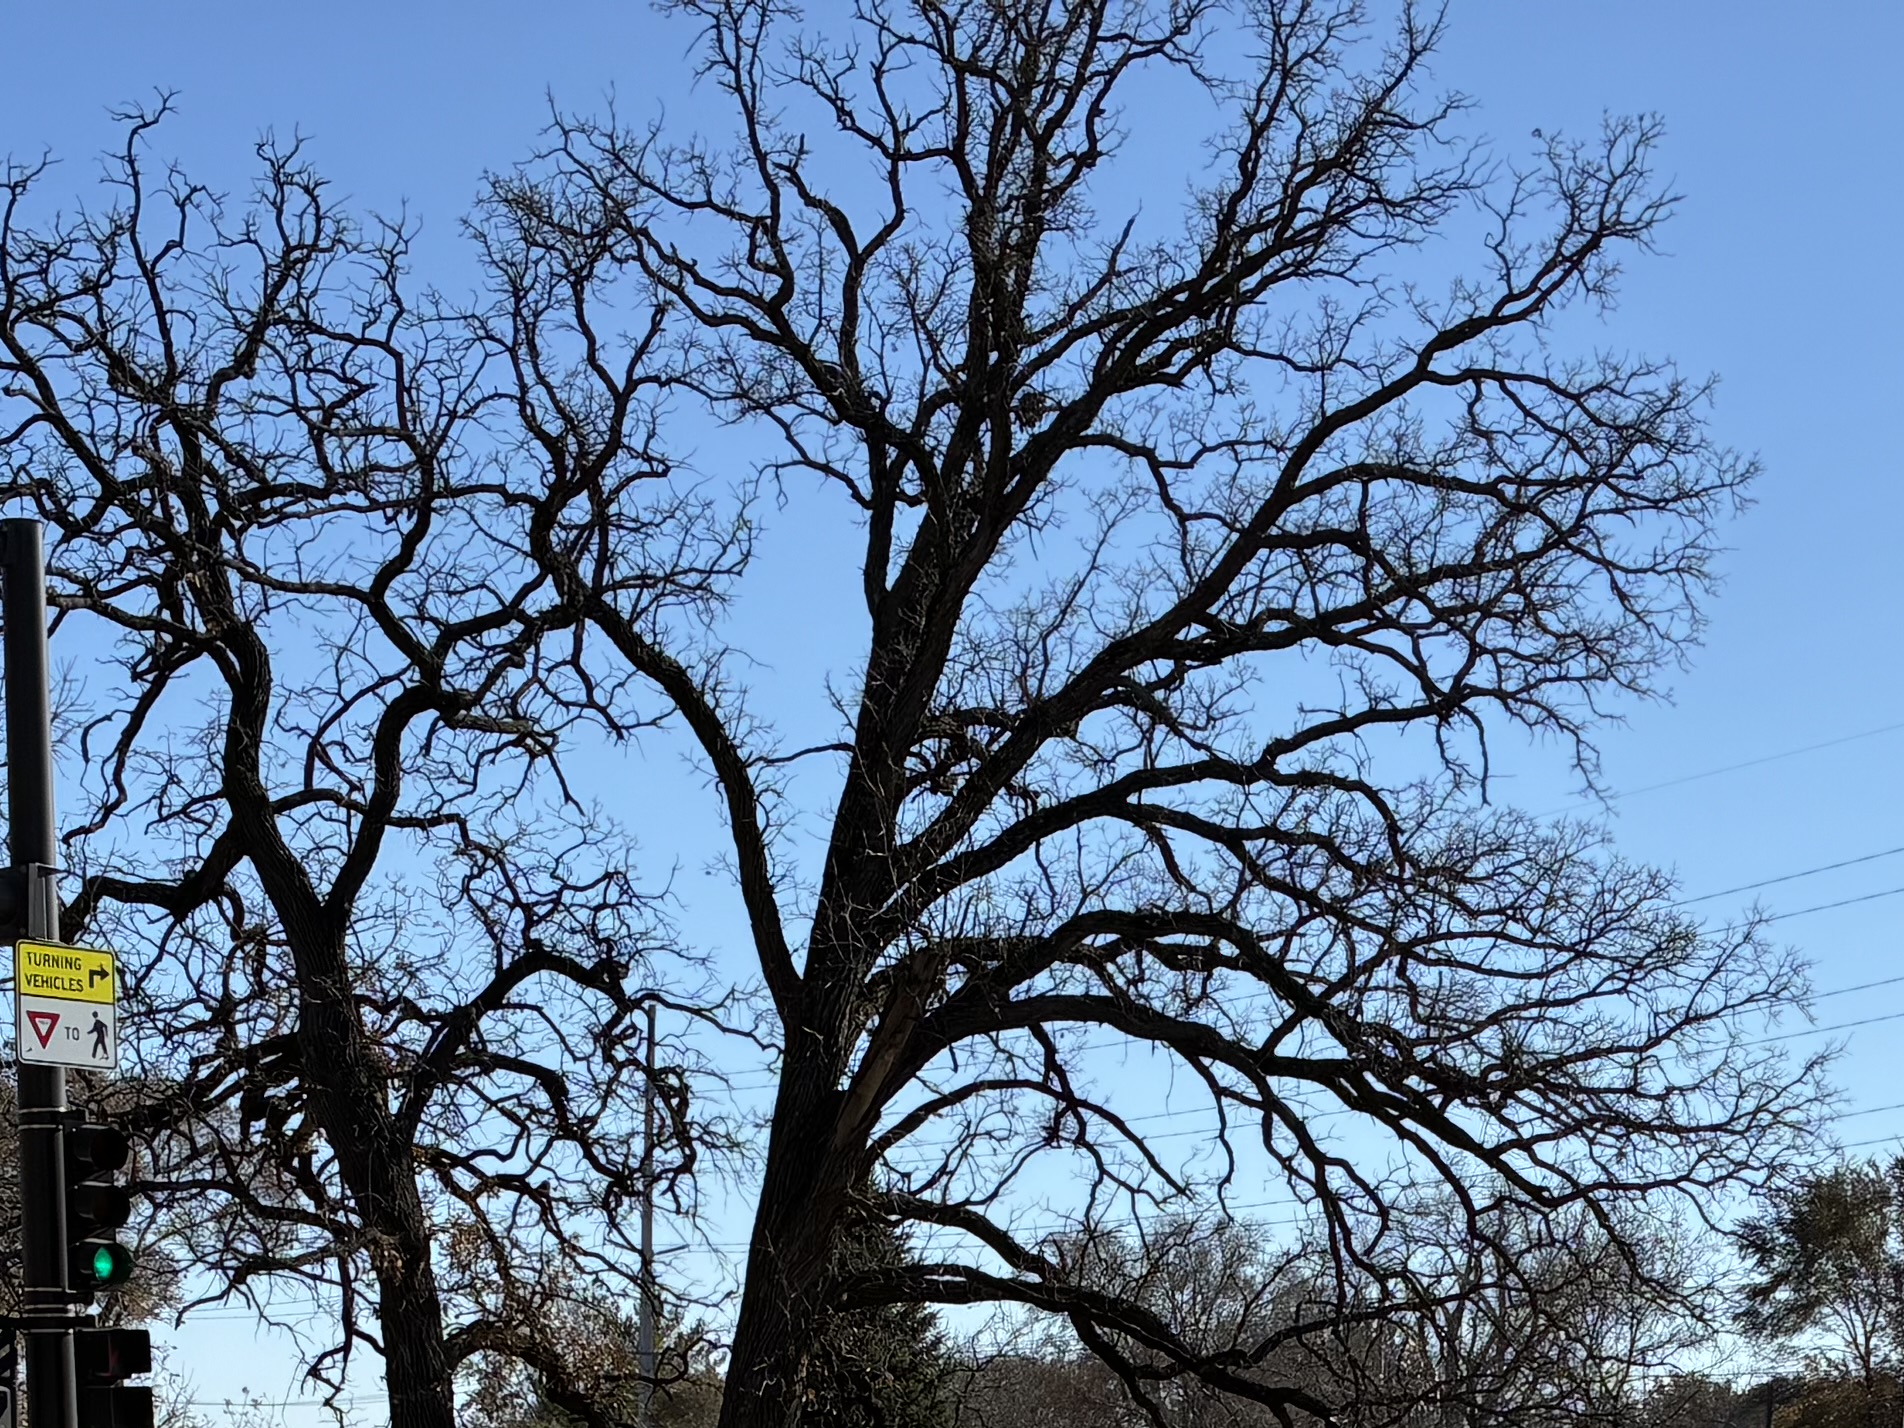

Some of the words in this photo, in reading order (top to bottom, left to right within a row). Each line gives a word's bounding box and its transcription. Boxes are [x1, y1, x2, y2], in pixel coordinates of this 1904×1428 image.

[26, 951, 81, 970] TURNING
[25, 974, 84, 992] VEHICLES
[64, 1026, 80, 1041] TO
